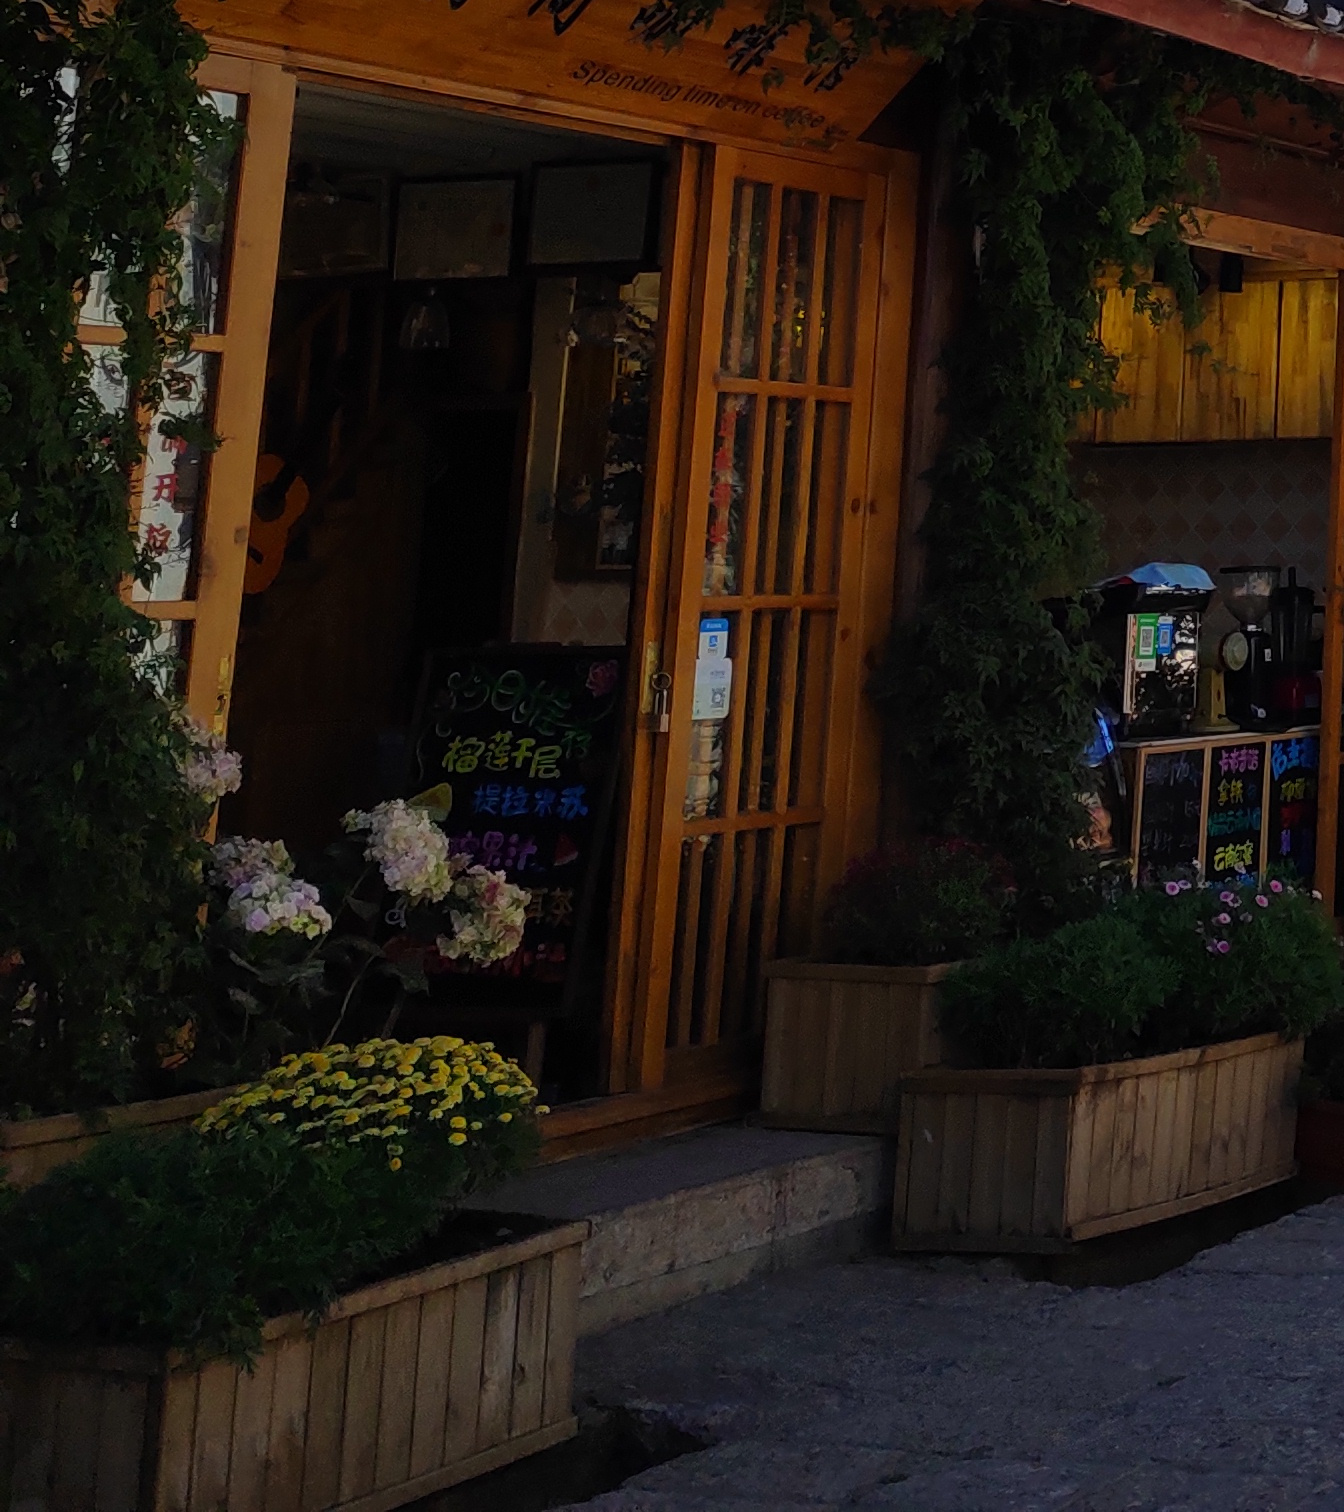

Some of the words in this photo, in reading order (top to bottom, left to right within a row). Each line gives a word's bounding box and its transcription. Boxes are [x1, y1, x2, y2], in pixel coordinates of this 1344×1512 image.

[573, 59, 683, 102] Spending
[682, 83, 728, 109] time
[442, 729, 564, 780] 榴莲千层
[472, 783, 590, 822] 提拉米苏
